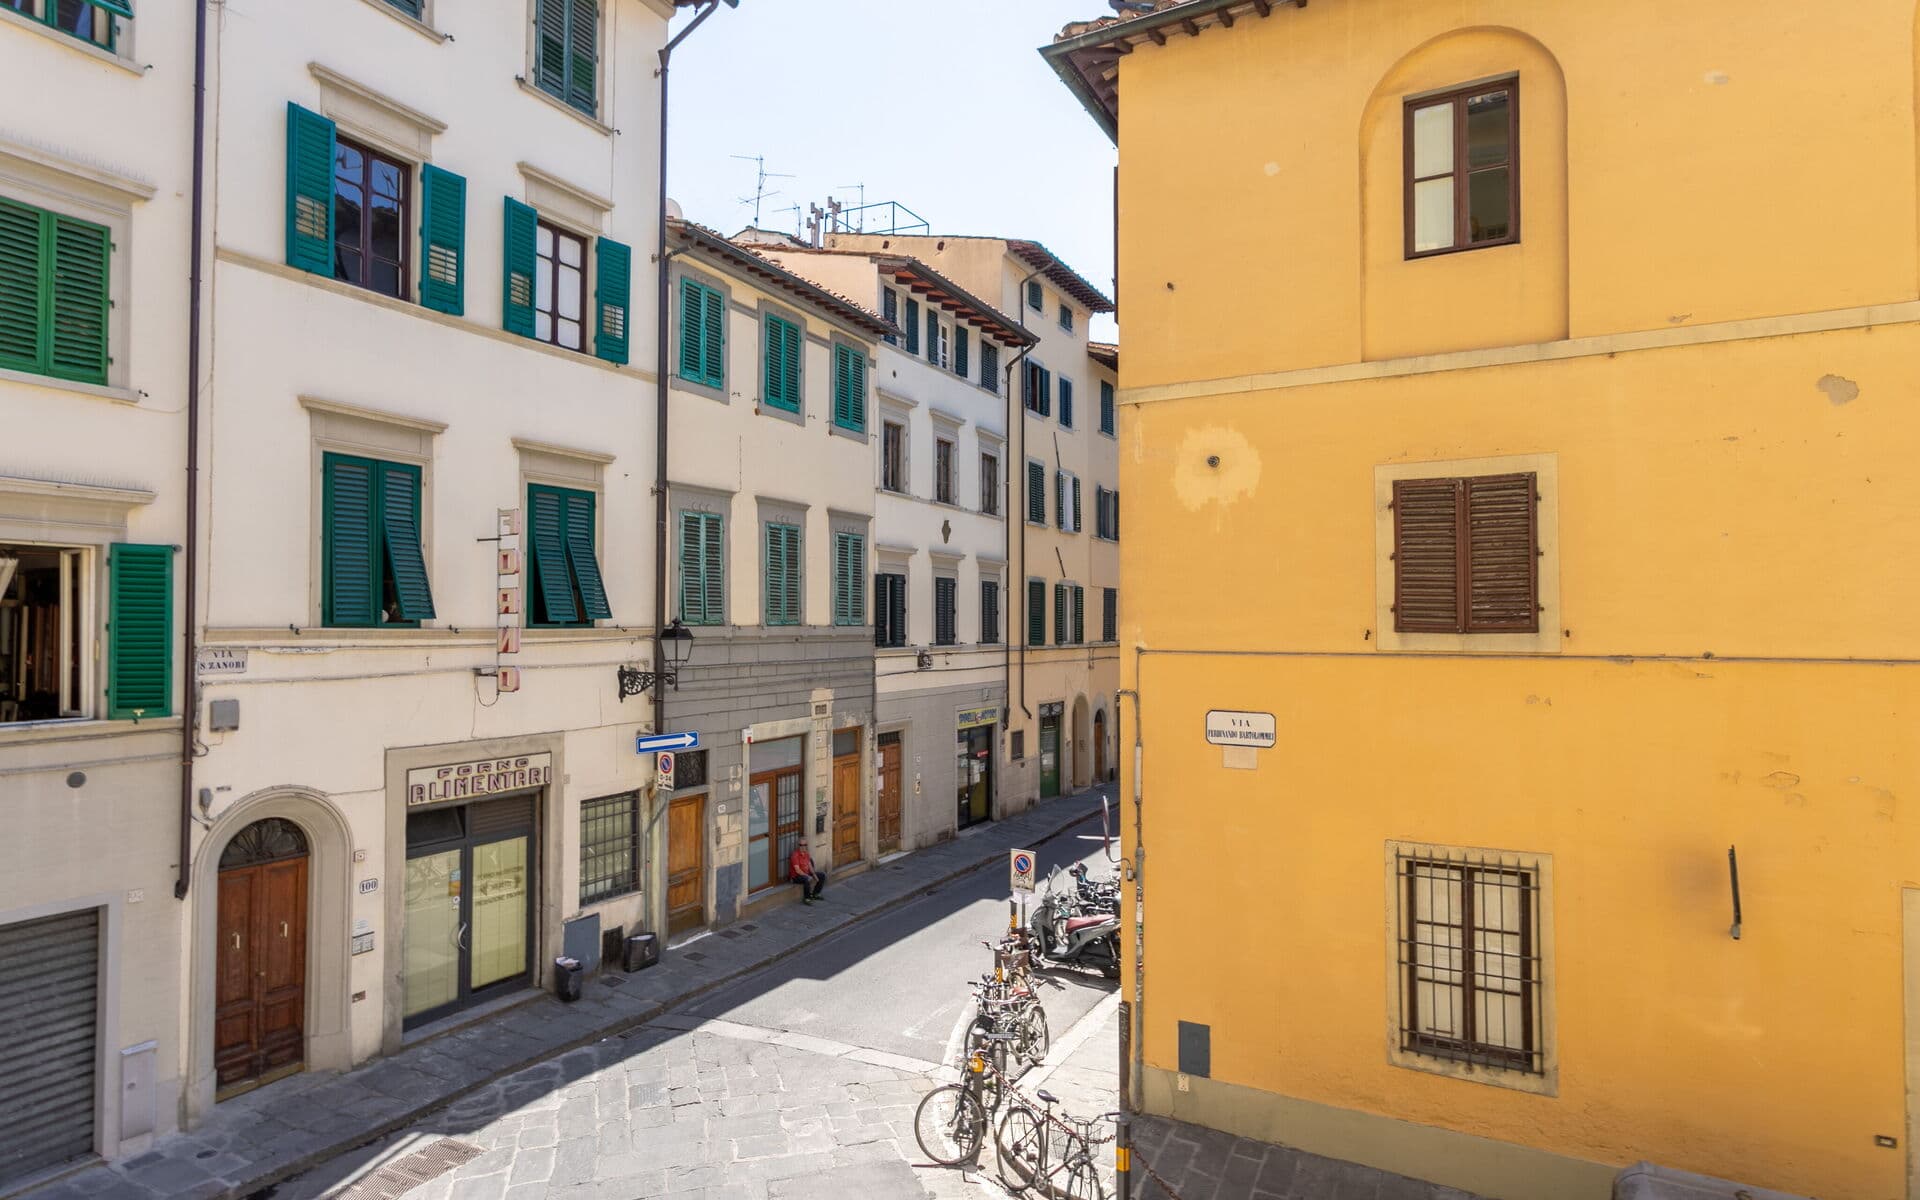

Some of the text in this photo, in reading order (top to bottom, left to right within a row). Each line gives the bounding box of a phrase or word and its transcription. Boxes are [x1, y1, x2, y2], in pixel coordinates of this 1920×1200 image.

[213, 649, 233, 658] VIA
[1231, 718, 1250, 727] VIA
[437, 758, 529, 779] FORNO
[410, 766, 551, 804] ALIMENTARI
[361, 880, 377, 892] 100
